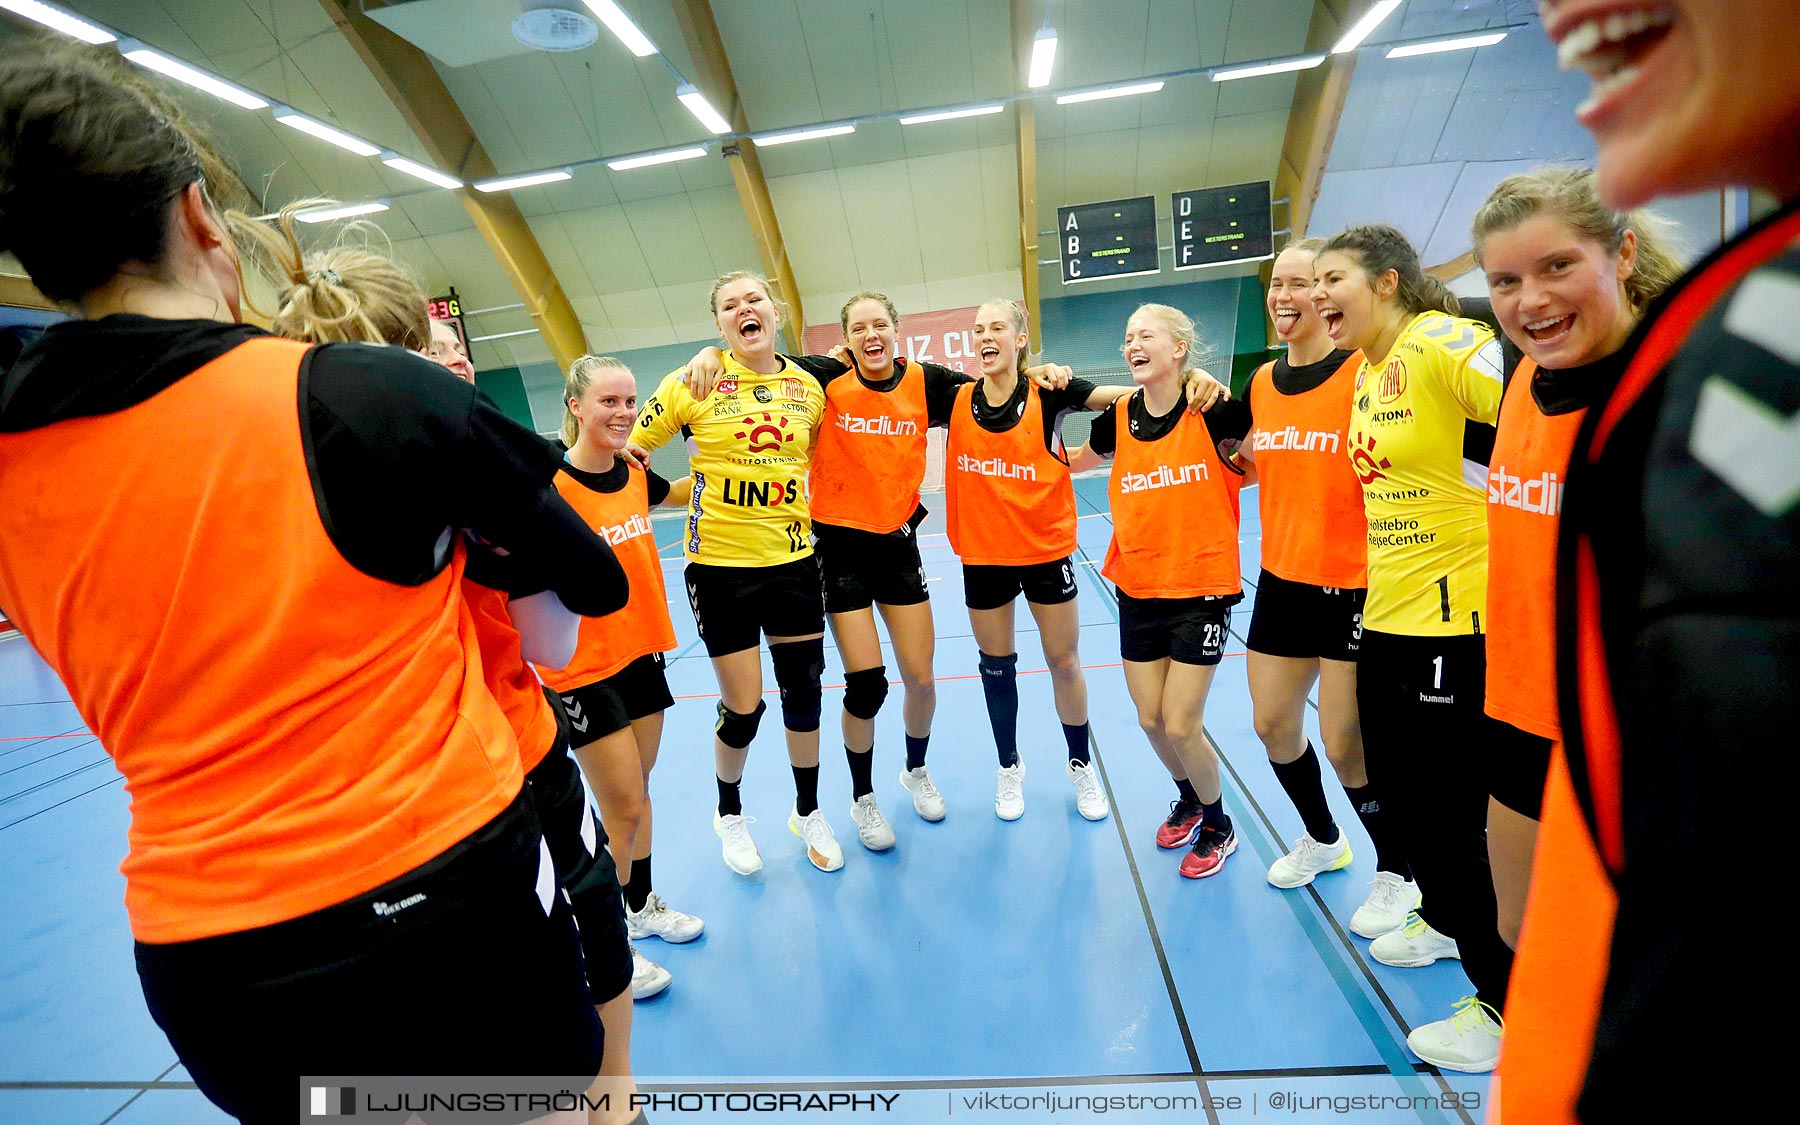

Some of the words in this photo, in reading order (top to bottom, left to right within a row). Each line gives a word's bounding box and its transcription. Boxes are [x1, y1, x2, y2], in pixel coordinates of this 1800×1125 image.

[1180, 197, 1192, 217] D
[1065, 212, 1079, 231] A
[1181, 220, 1193, 241] E
[1068, 235, 1080, 255] B
[1204, 232, 1245, 243] WESTERSTRAND
[1091, 247, 1131, 258] WESTERSTRAND
[1182, 244, 1194, 264] F
[1069, 258, 1081, 278] C
[835, 412, 918, 437] stadium
[1252, 425, 1340, 454] tadium
[957, 453, 1037, 482] stadium
[1121, 464, 1209, 494] stadium
[723, 477, 797, 508] LINDS
[785, 520, 807, 553] 12
[1061, 564, 1071, 585] 6
[1434, 574, 1451, 622] 1
[1202, 623, 1221, 647] 23
[1432, 655, 1443, 689] 1
[1419, 691, 1454, 704] hummel
